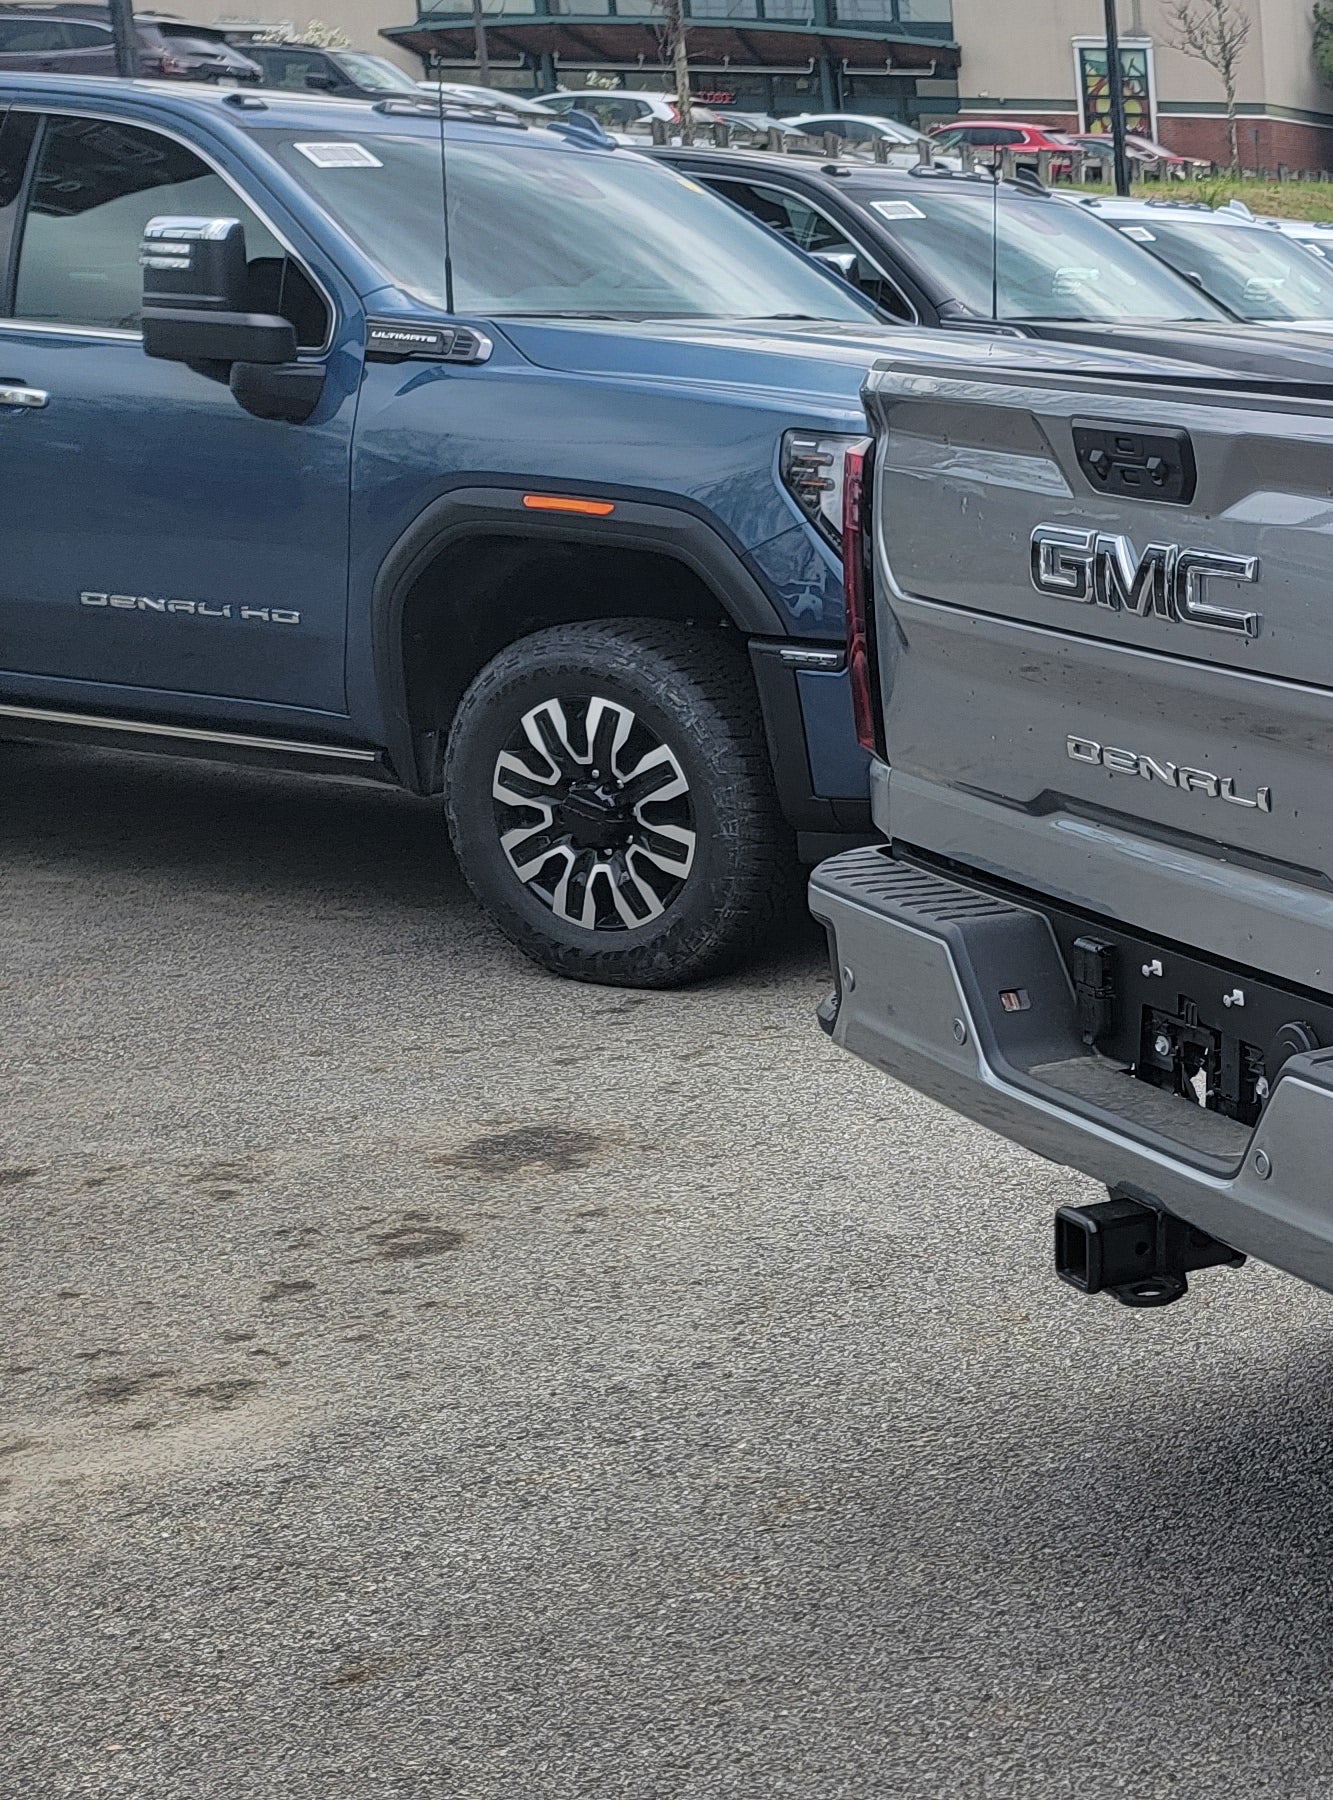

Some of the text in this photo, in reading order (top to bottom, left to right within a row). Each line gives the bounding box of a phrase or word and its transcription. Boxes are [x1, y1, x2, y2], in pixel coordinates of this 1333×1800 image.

[371, 330, 437, 343] ULTIMATE
[80, 591, 301, 624] DENALI HD
[1030, 522, 1261, 639] GMC
[1066, 734, 1272, 813] DENALI
